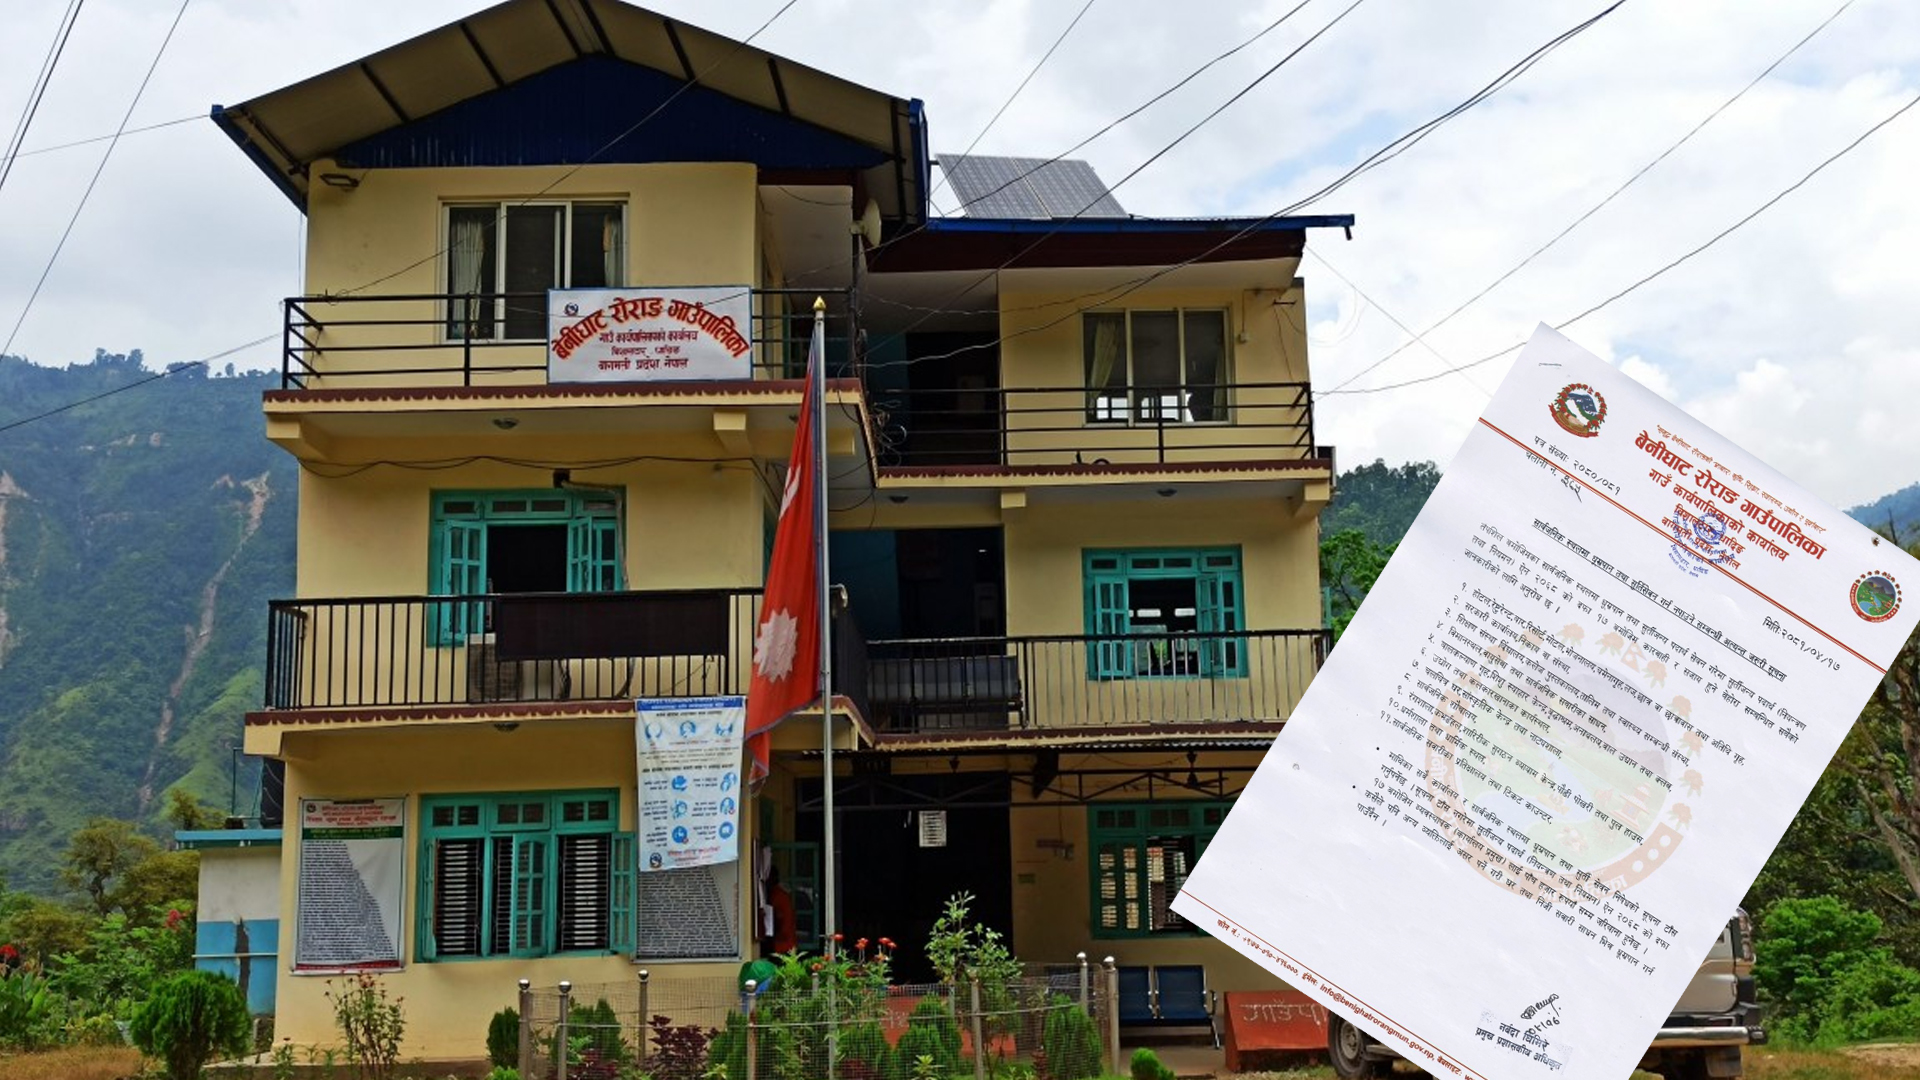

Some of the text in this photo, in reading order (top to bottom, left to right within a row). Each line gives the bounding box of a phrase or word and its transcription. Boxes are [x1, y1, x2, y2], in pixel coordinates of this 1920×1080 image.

[552, 297, 750, 359] बेनीघाट रोराङ गाउँपालिका
[1534, 436, 1620, 496] पत्र २०८०/०८१
[1635, 430, 1826, 559] बेनीघाट रोराङ गाउँपालिका
[1649, 469, 1789, 560] गाउँ कार्यपालिकाको कार्यालय
[1464, 548, 1554, 609] जानकारीको लागि अनुरोध छ
[1465, 602, 1490, 622] सरकारी
[1472, 535, 1718, 693] तथा नियमन) ऐन २०६८ को दफा १७ र सजाय हुने
[1480, 523, 1504, 542] तपशिल
[1576, 582, 1600, 602] स्थलमा
[1626, 613, 1640, 627] तथा
[1670, 641, 1690, 656] पदार्थ
[1708, 664, 1727, 680] गरेमा
[1758, 695, 1777, 711] पदार्थ
[1566, 538, 1591, 558] स्थलमा
[1615, 569, 1630, 582] तथा
[1660, 597, 1674, 609] गर्न
[1673, 605, 1696, 624] नपाउने
[1722, 637, 1748, 657] अत्यन्त
[1765, 664, 1787, 682] सूचना
[1453, 667, 1468, 680] तथा
[1469, 676, 1520, 712] कलकारखानाका
[1456, 613, 1478, 632] शिक्षण
[1479, 629, 1498, 644] संस्था
[1602, 706, 1617, 719] तथा
[1510, 666, 1524, 679] तथा
[1429, 723, 1444, 736] तथा
[1445, 733, 1468, 750] धार्मिक
[1496, 709, 1513, 726] केन्द्र
[1513, 722, 1528, 735] तथा
[1695, 728, 1710, 742] तथा
[1711, 739, 1732, 755] अतिथि
[1488, 778, 1502, 791] तथा
[1503, 786, 1524, 805] टिकट
[1639, 765, 1654, 778] तथा
[1574, 794, 1594, 812] पोखरी
[1595, 809, 1610, 822] तथा
[1608, 818, 1624, 831] पुल
[1374, 778, 1385, 789] १७
[1453, 827, 1485, 851] (कार्यालय
[1485, 847, 1507, 865] प्रमुख)
[1508, 862, 1524, 876] लाई
[1538, 880, 1557, 898] हजार
[1578, 906, 1595, 920] सम्म
[1621, 934, 1642, 951] हुनेछ
[1389, 751, 1413, 771] माथिका
[1431, 778, 1459, 800] कार्यालय
[1463, 798, 1468, 806] र
[1506, 825, 1531, 844] स्थलमा
[1559, 858, 1574, 871] तथा
[1612, 890, 1640, 913] निषेधको
[1642, 910, 1662, 926] सूचना
[1664, 924, 1678, 937] टाँस
[1415, 786, 1435, 802] सूचना
[1453, 809, 1476, 828] नगरेमा
[1507, 842, 1526, 858] पदार्थ
[1558, 875, 1573, 888] तथा
[1573, 883, 1601, 906] नियमन)
[1603, 901, 1614, 915] ऐन
[1617, 912, 1640, 931] २०६८
[1642, 928, 1653, 939] को
[1655, 936, 1670, 950] दफा
[1365, 790, 1385, 806] कसैले
[1387, 803, 1401, 816] पनि
[1403, 814, 1419, 828] अन्य
[1456, 848, 1474, 863] असर
[1490, 868, 1503, 880] गरी
[1506, 878, 1517, 890] घर
[1519, 887, 1534, 899] तथा
[1536, 896, 1553, 912] निजी
[1578, 924, 1597, 940] साधन
[1642, 964, 1656, 976] गर्न
[1475, 1027, 1562, 1071] प्रमुख प्रशासकीय अधिकृत
[1522, 1032, 1550, 1052] घिमिरे
